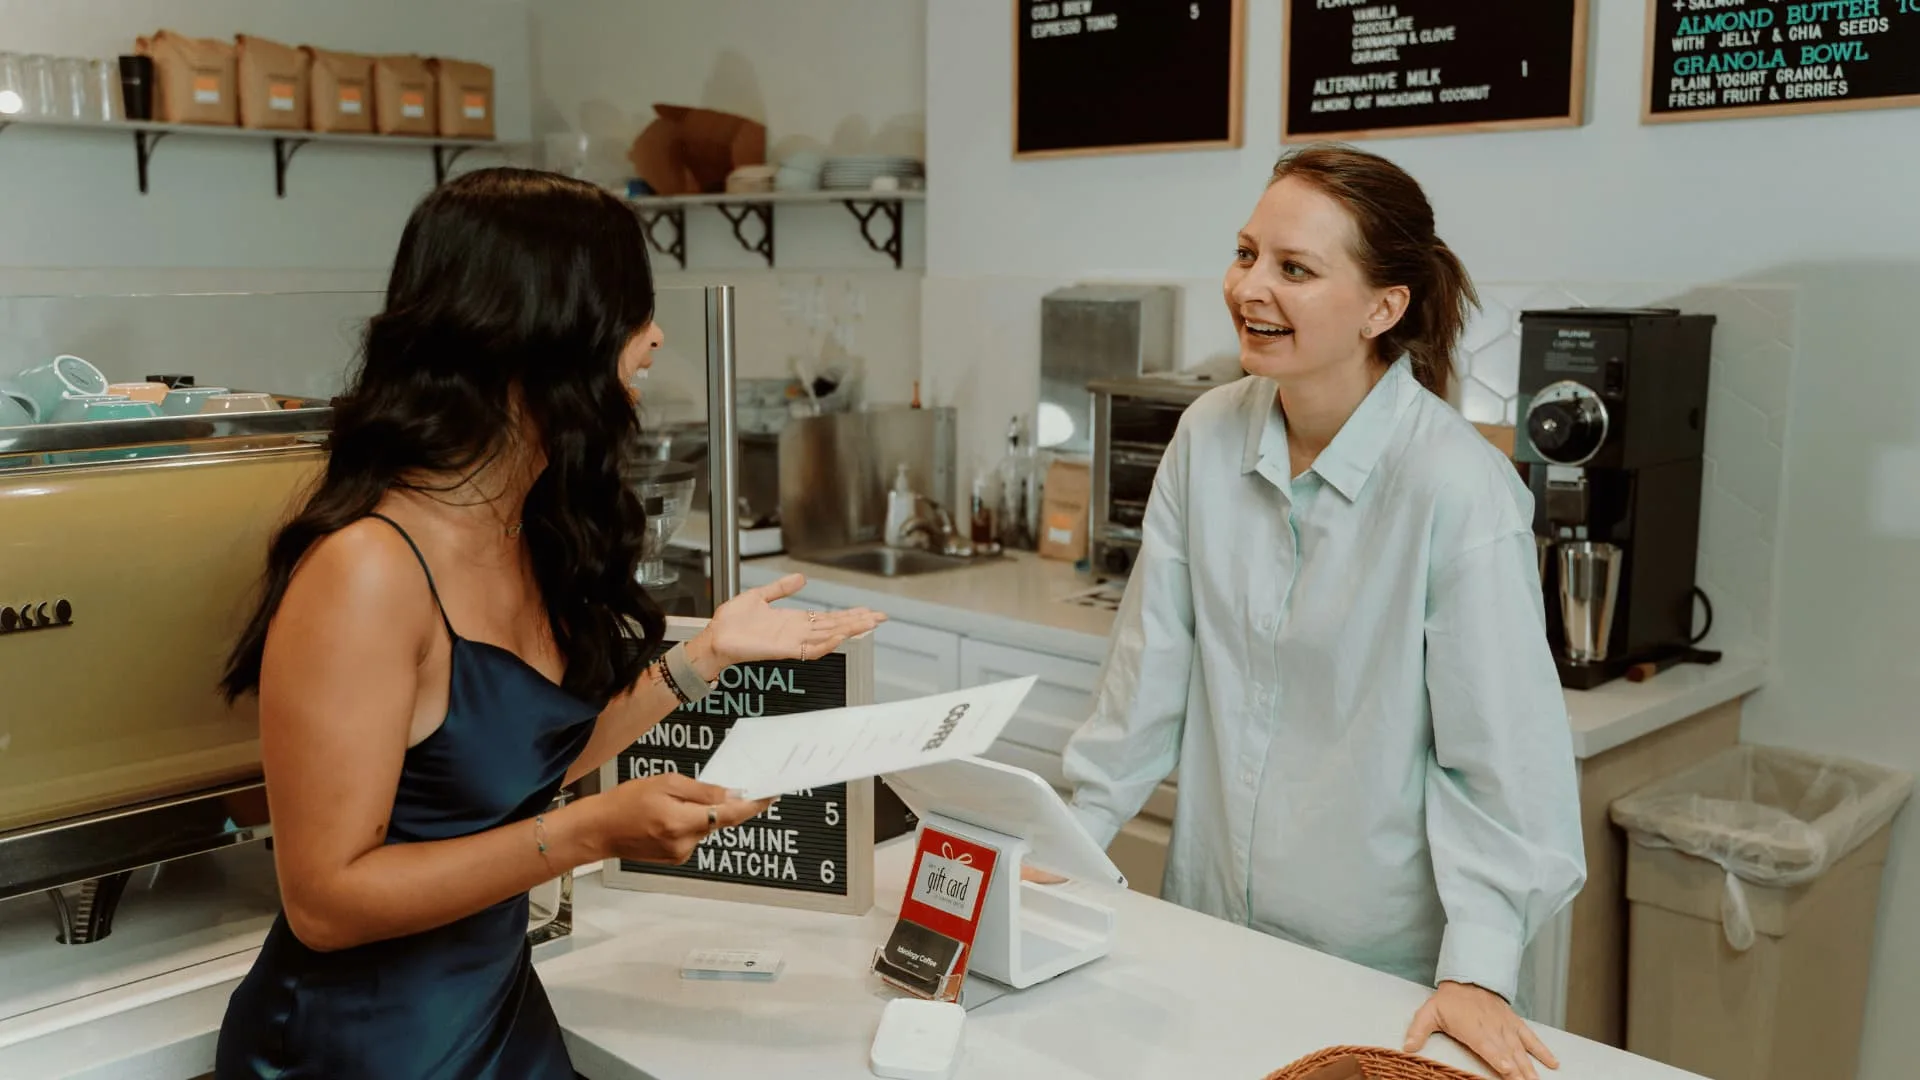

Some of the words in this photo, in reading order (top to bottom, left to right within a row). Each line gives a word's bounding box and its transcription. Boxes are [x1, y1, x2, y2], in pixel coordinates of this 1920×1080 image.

[1189, 3, 1200, 20] 5
[1352, 5, 1397, 22] VANILLA
[1676, 8, 1774, 36] ALMOND
[1786, 0, 1880, 25] BUTTER
[1031, 18, 1082, 39] ESPRESSO
[1352, 16, 1414, 36] CHOCOLATE
[1352, 33, 1407, 50] CINNAMON
[1420, 25, 1456, 43] CLOVE
[1672, 35, 1705, 52] WITH
[1719, 29, 1760, 48] JELLY
[1772, 28, 1783, 43] &
[1788, 24, 1823, 41] CHIA
[1839, 17, 1890, 36] SEEDS
[1673, 48, 1787, 76] GRANOLA
[1801, 41, 1869, 65] BOWL
[1313, 72, 1398, 96] ALTERNATIVE
[1406, 68, 1441, 87] MILK
[1671, 74, 1711, 92] PLAIN
[1715, 70, 1768, 88] YOGURT
[1776, 64, 1844, 84] GRANOLA
[1311, 96, 1351, 113] ALMOND
[1439, 85, 1491, 102] COCONUT
[1668, 90, 1716, 107] FRESH
[1723, 86, 1763, 104] FRUIT
[1769, 85, 1780, 100] &
[1785, 80, 1849, 99] BERRIES
[825, 801, 840, 826] 5
[697, 847, 797, 881] MATCHA
[820, 860, 836, 884] 6
[926, 867, 946, 894] gift
[946, 876, 970, 901] card
